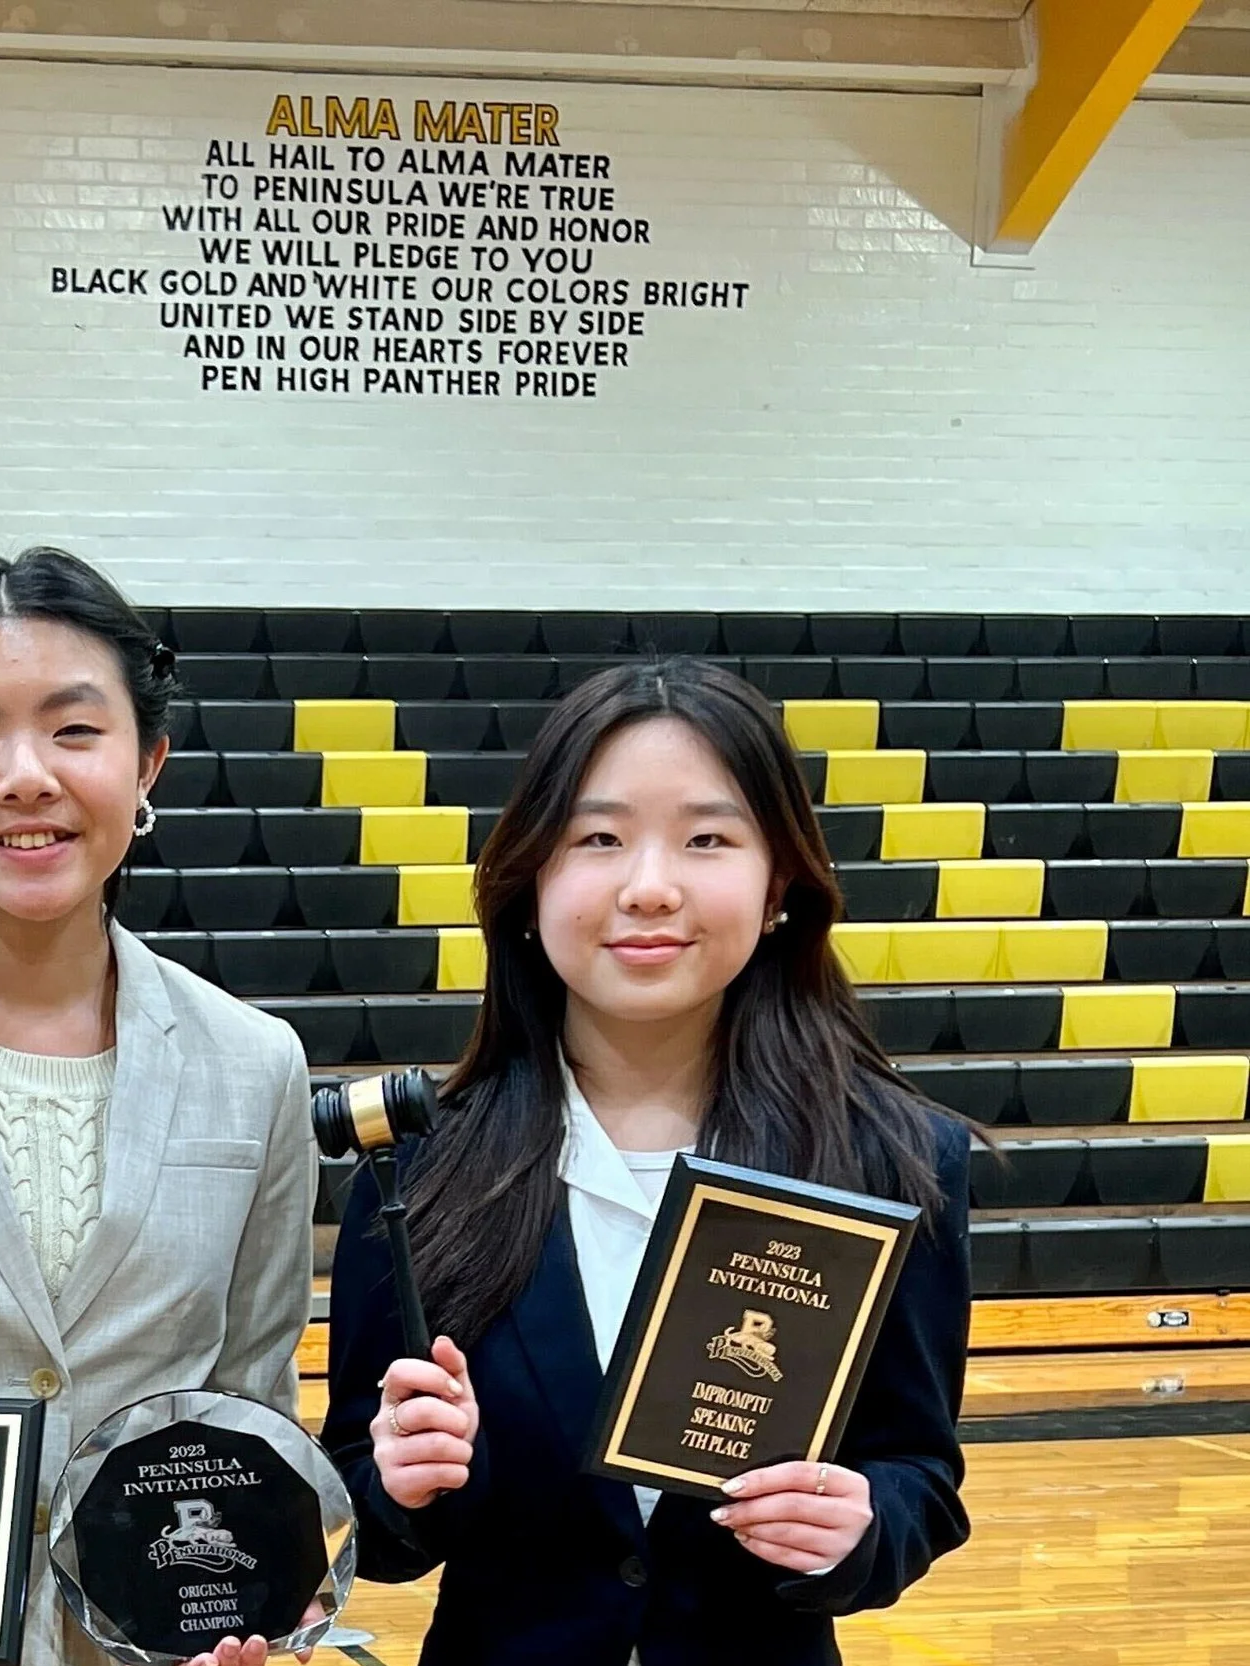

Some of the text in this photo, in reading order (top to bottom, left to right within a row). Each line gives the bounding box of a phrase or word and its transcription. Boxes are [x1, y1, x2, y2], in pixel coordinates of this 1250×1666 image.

[266, 94, 559, 146] ALMA MATER
[205, 139, 610, 180] ALL HAIL TO ALMA MATER
[201, 173, 615, 212] TO PENINSULA WE'RE TRUE
[162, 205, 650, 244] WITH ALL OUR PRIDE AND HONOR
[199, 237, 593, 274] WE WILL PLEDGE TO YOU
[52, 267, 750, 309] BLACK GOLD AND WHITE OUR COLORS BRIGHT
[160, 302, 645, 336] UNITED WE STAND SIDE BY SIDE
[183, 334, 628, 367] AND IN OUR HEARTS FOREVER
[202, 365, 597, 397] PEN HIGH PANTHER PRIDE
[766, 1240, 801, 1260] 2023
[729, 1253, 821, 1287] PENINSULA
[708, 1269, 830, 1310] INVITATIONAL
[692, 1382, 772, 1414] IMPROMPTU
[691, 1406, 756, 1435] SPEAKING
[169, 1444, 206, 1459] 2023
[681, 1429, 751, 1460] 7TH PLACE
[124, 1472, 262, 1496] INVITATIONAL
[138, 1458, 242, 1478] PENINSULA
[179, 1582, 237, 1598] ORIGINAL
[181, 1599, 238, 1614] ORATORY
[180, 1614, 244, 1632] CHAMPION
